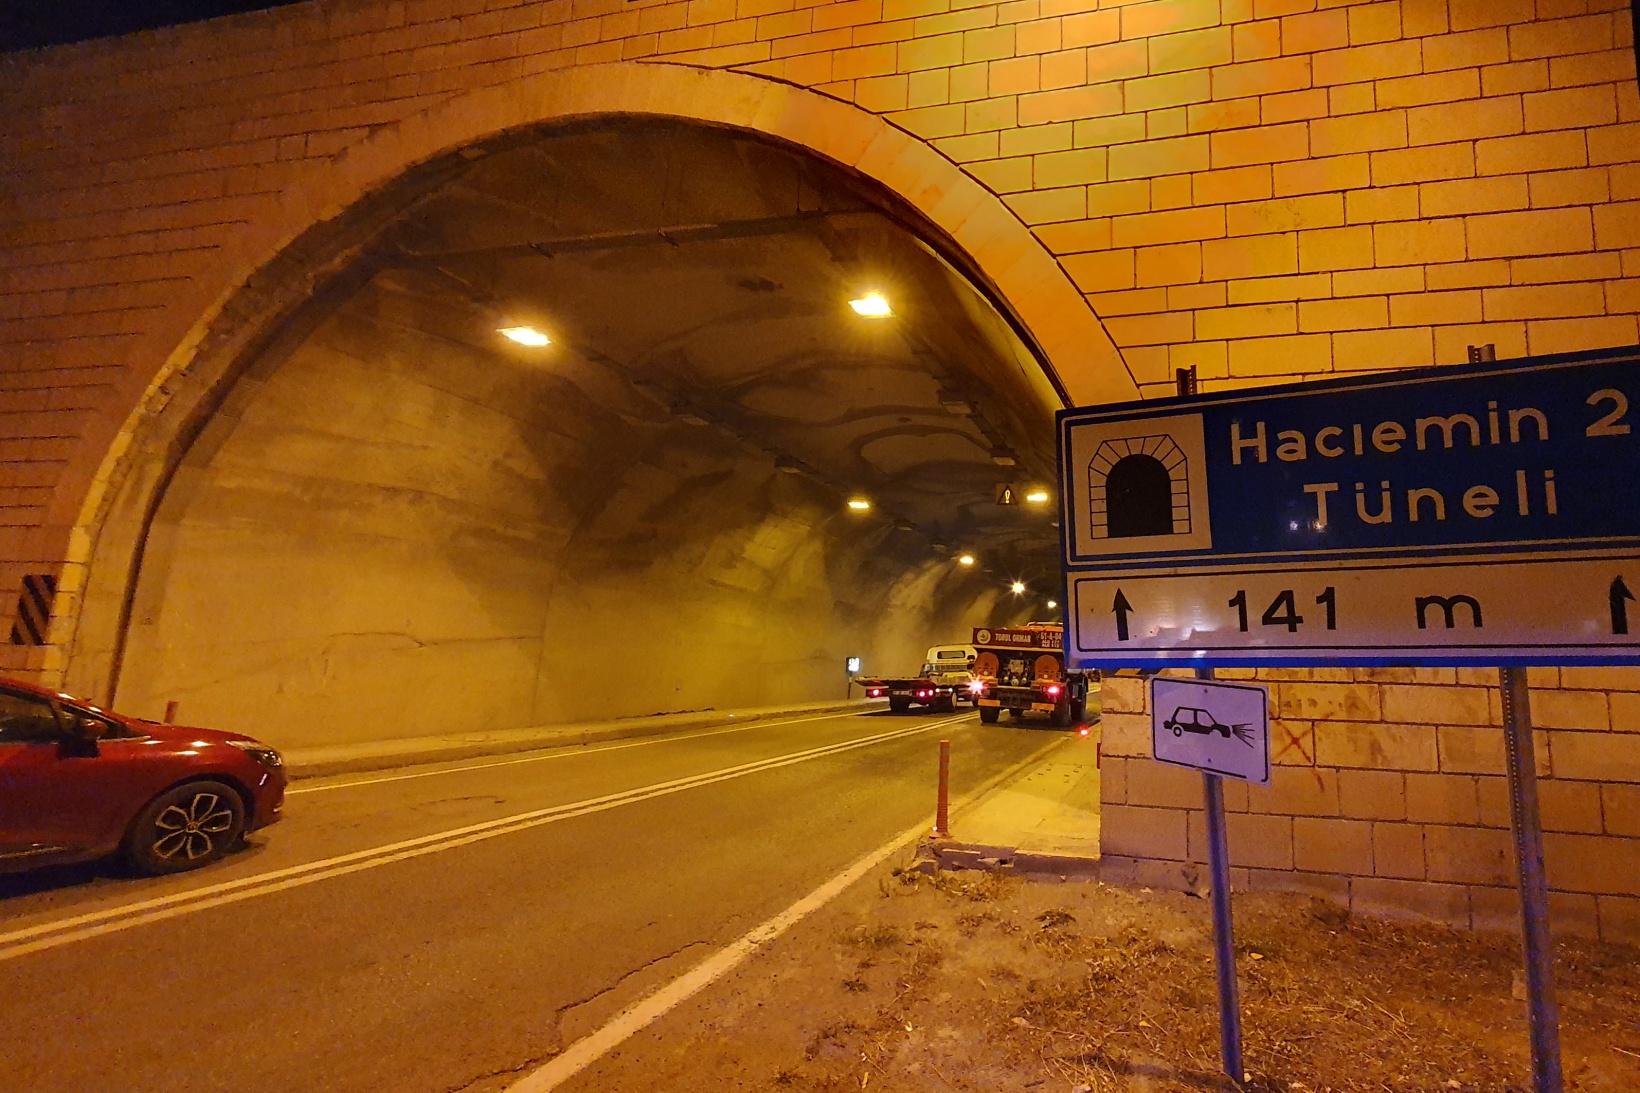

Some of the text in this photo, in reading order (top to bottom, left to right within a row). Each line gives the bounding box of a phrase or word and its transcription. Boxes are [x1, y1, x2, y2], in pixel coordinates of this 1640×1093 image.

[1230, 388, 1630, 464] Hacıemin 2
[1303, 469, 1558, 527] Tüneli
[1228, 587, 1484, 632] 141 m
